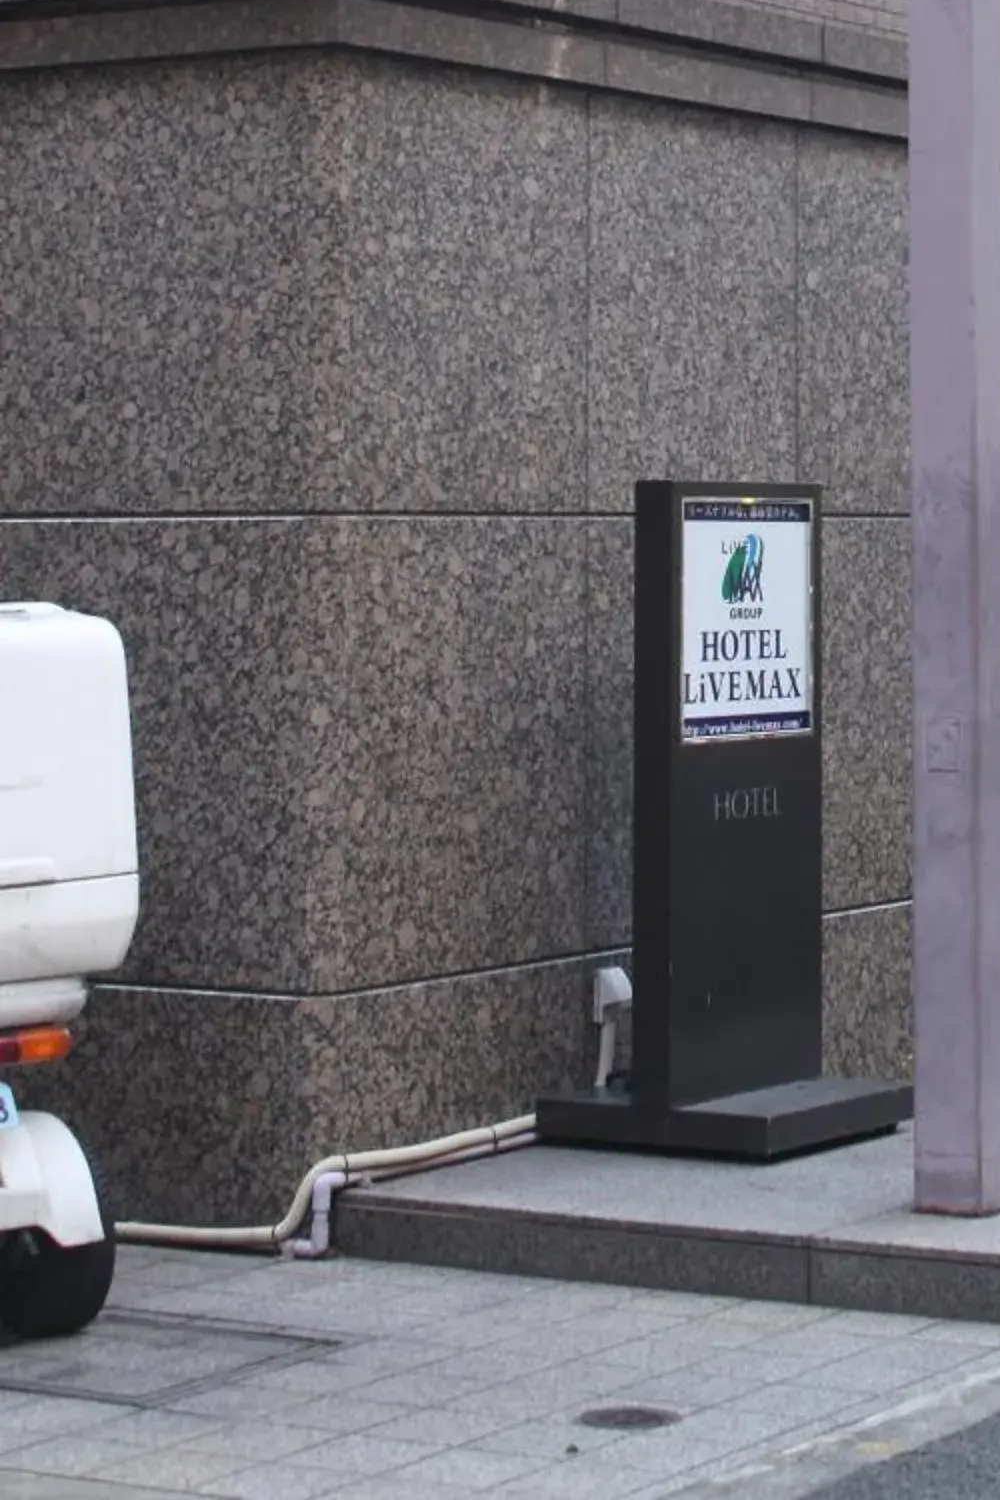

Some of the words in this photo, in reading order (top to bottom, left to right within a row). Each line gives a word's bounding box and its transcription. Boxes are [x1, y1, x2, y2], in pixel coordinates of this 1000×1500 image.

[729, 607, 764, 620] GROUP
[700, 629, 788, 662] HOTEL
[713, 786, 785, 821] HOTEL
